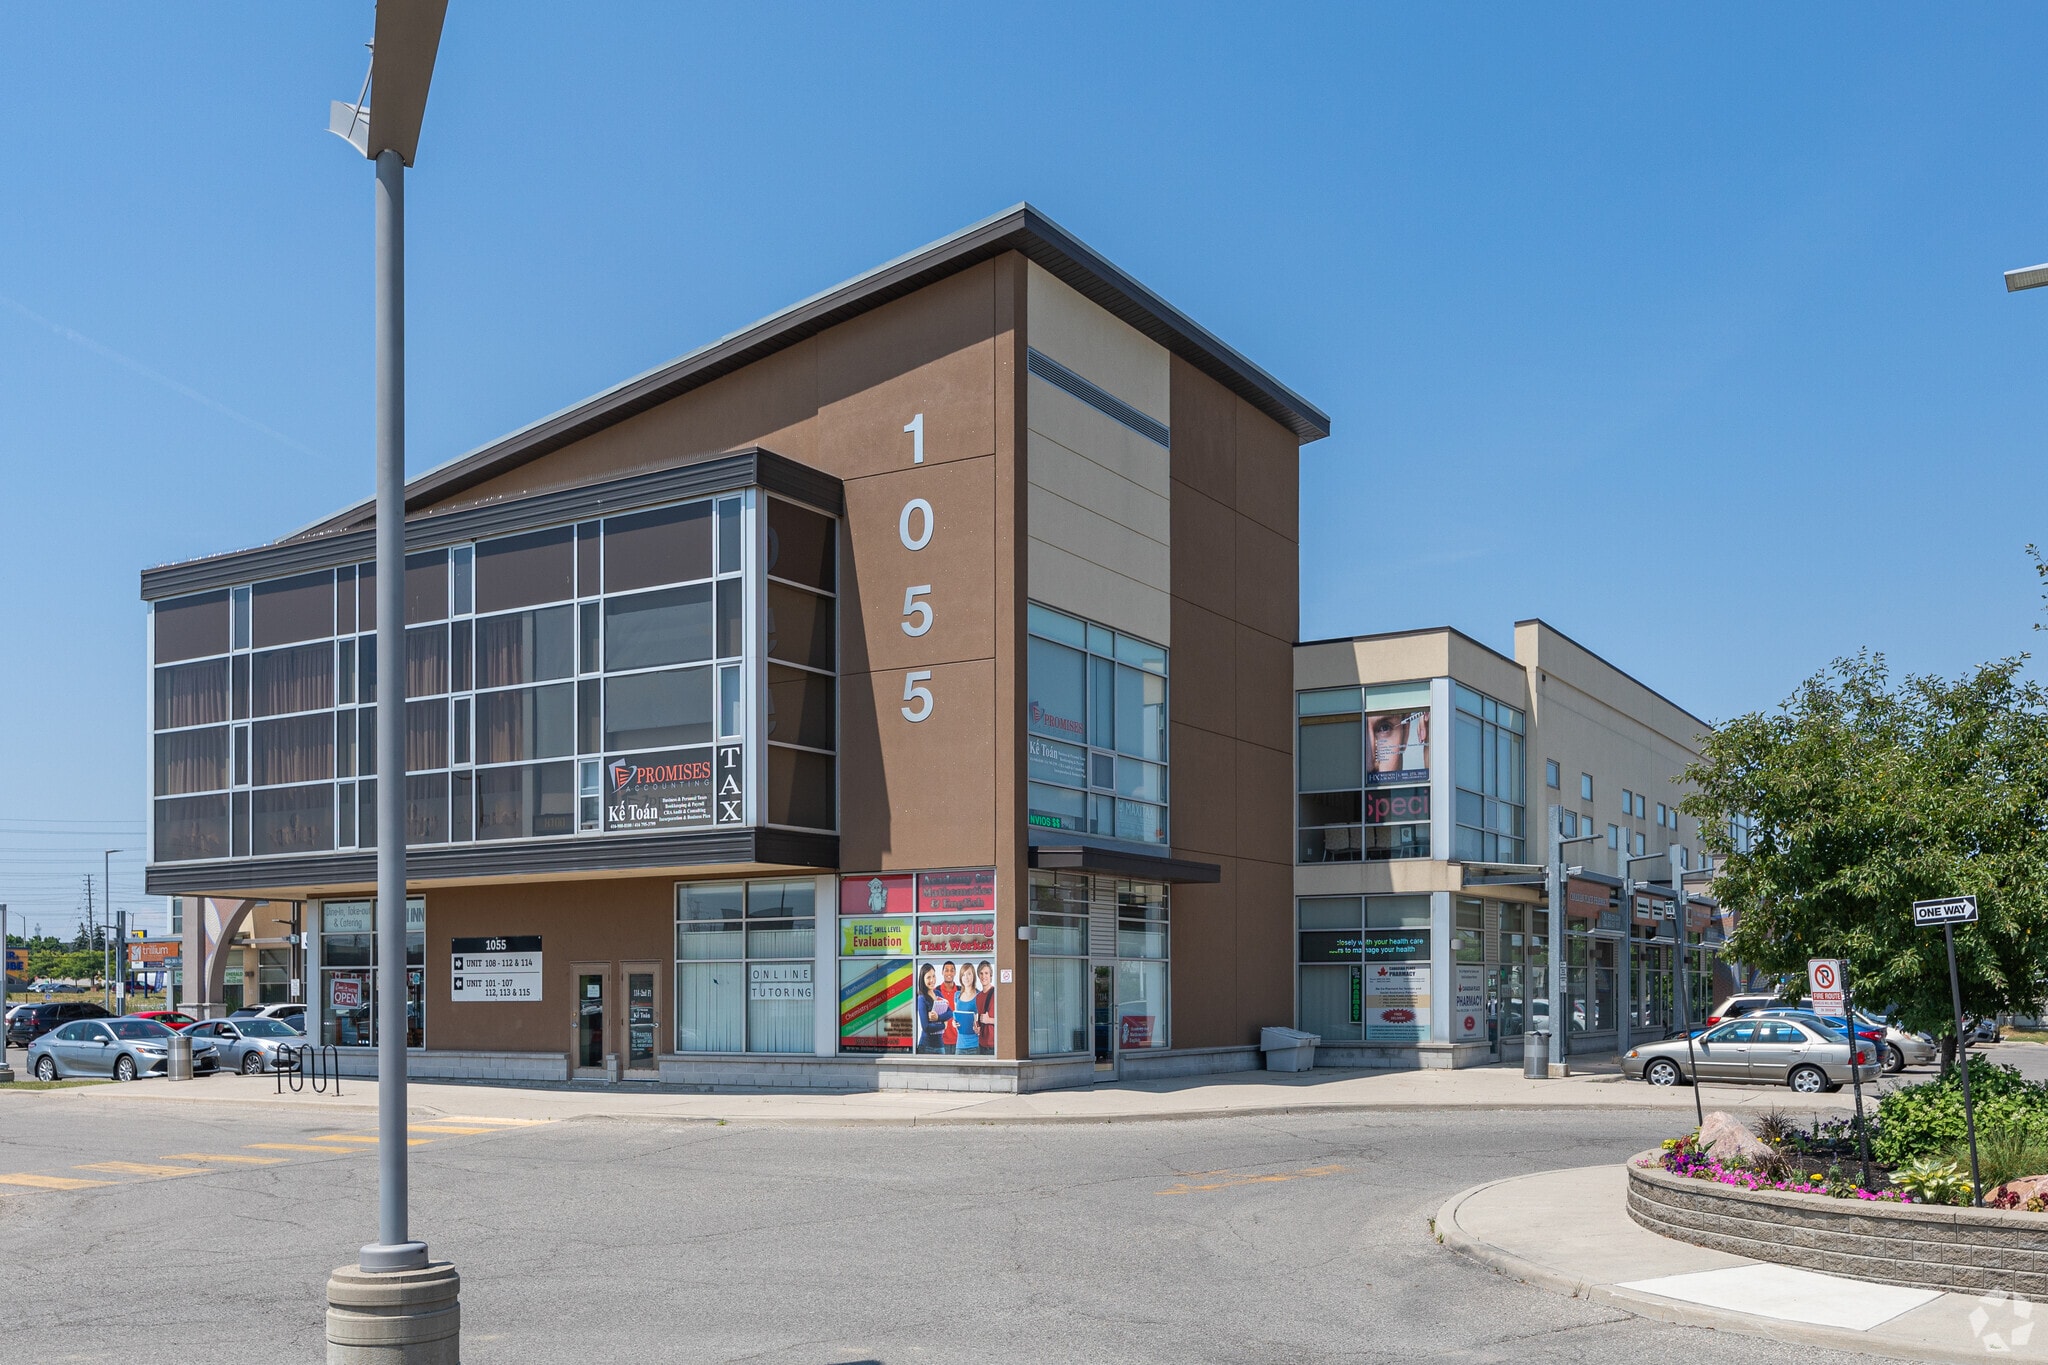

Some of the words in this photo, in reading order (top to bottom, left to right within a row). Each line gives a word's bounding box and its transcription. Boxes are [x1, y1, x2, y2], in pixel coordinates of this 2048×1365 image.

[899, 413, 934, 722] 1055
[1044, 714, 1085, 735] PROMISES
[1041, 743, 1058, 759] Toán
[637, 761, 711, 784] PROMISES
[625, 779, 710, 792] ACCOUNTING
[718, 747, 741, 821] TAX
[608, 800, 626, 822] Kế
[628, 802, 658, 820] Toán
[923, 886, 992, 897] Mathematics
[942, 898, 984, 911] English
[1919, 907, 1942, 918] ONE
[1944, 904, 1966, 915] WAY
[340, 918, 362, 928] Catering
[920, 920, 994, 937] Tutoring
[853, 925, 873, 935] FREE
[486, 939, 507, 951] 1055
[853, 936, 902, 947] Evaluation
[920, 939, 948, 951] That
[142, 945, 169, 955] trillium
[466, 959, 482, 967] UNIT
[485, 959, 497, 967] 108
[502, 959, 513, 967] 112
[514, 959, 519, 967] &
[521, 958, 533, 966] 114
[753, 969, 808, 979] ONLINE
[466, 979, 482, 987] UNIT
[485, 979, 496, 987] 101
[502, 979, 513, 987] 107
[335, 991, 358, 1003] OPEN
[500, 988, 511, 997] 113
[512, 988, 517, 996] &
[519, 988, 531, 996] 115
[752, 988, 811, 997] TUTORING
[1825, 992, 1841, 1000] ROUTE
[1456, 996, 1482, 1007] PHARMACY
[845, 1004, 870, 1020] Chemistry
